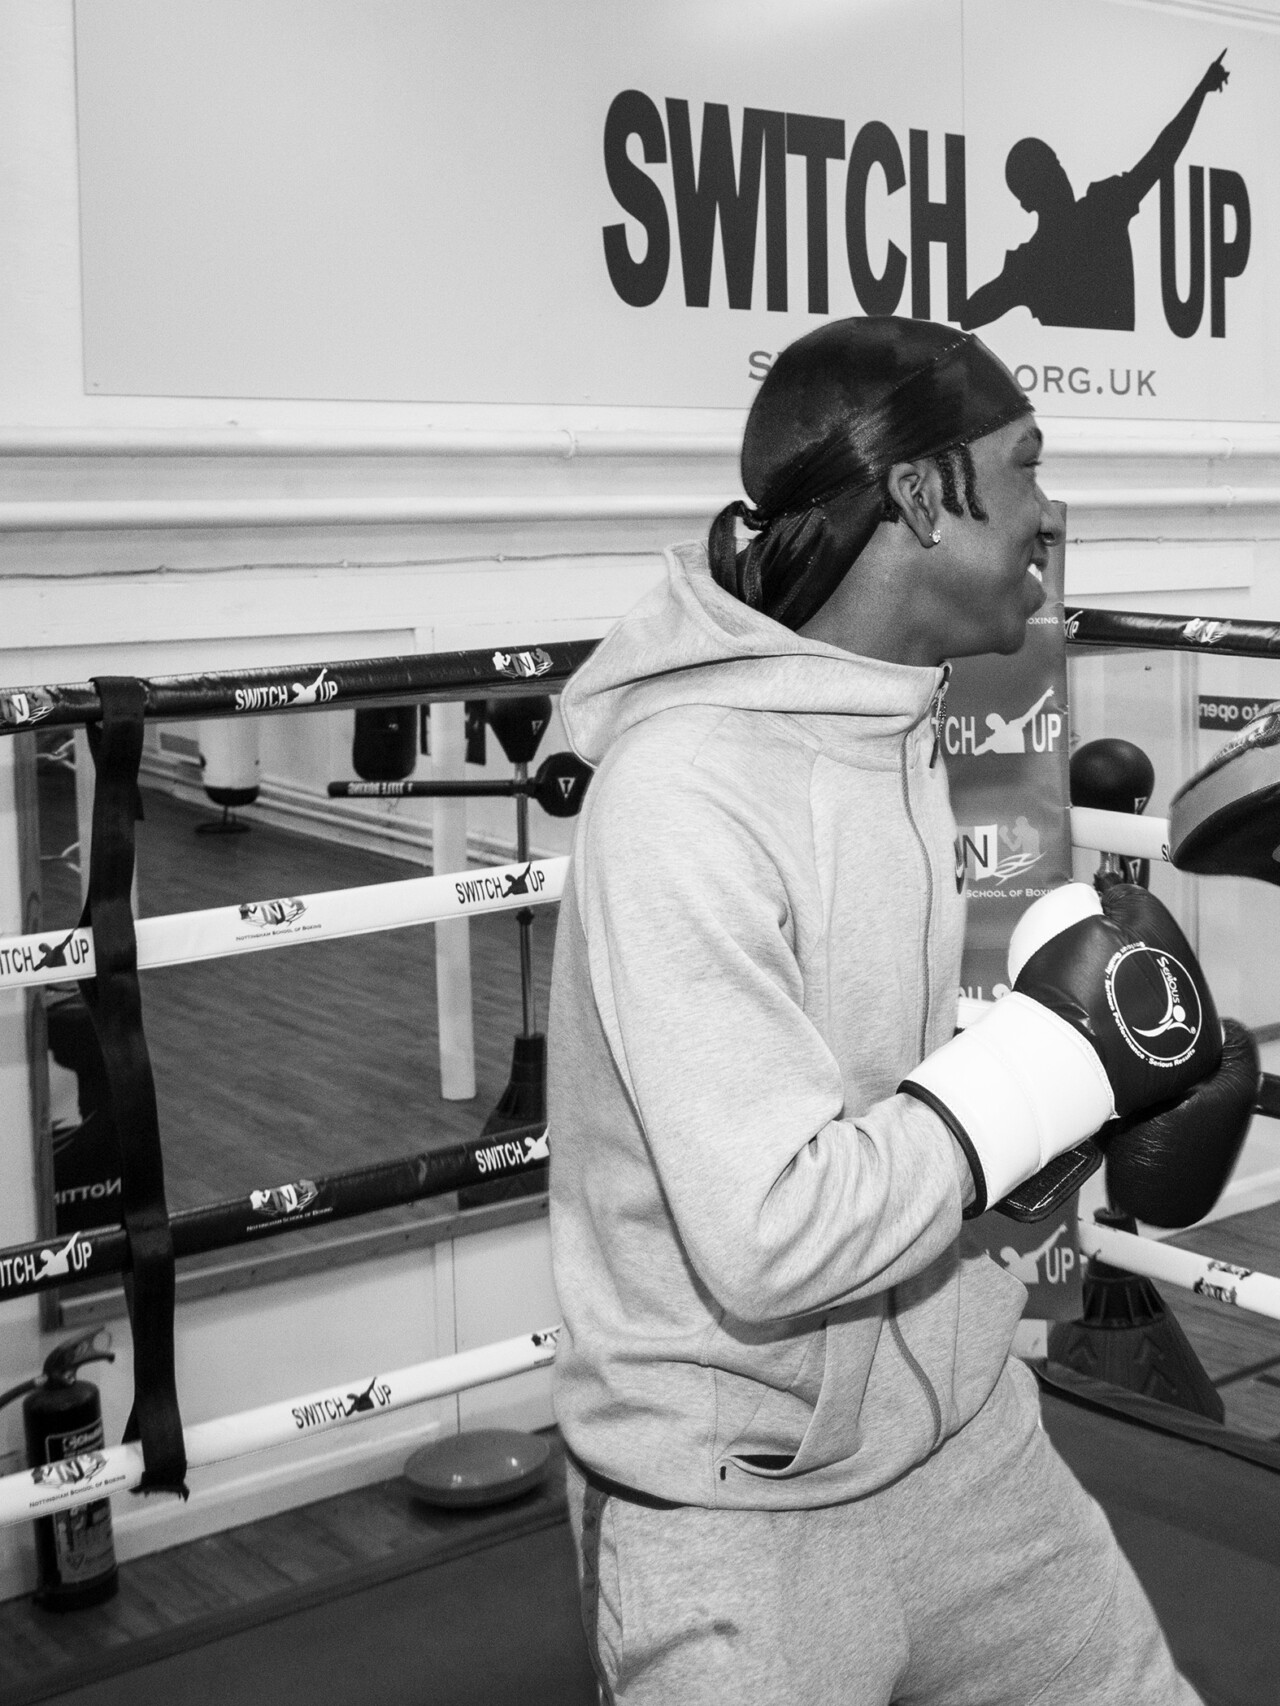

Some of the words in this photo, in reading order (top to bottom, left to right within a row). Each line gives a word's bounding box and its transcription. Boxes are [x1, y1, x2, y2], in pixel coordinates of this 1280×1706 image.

[602, 88, 968, 323] SWITCH
[1158, 164, 1251, 338] UP
[1016, 364, 1157, 397] ORG.UK
[1027, 616, 1059, 625] OXING
[235, 686, 289, 710] SWITCH
[319, 680, 338, 702] UP
[1031, 713, 1062, 753] UP
[455, 877, 504, 904] SWITCH
[528, 870, 545, 892] UP
[0, 946, 35, 975] ITCH
[69, 939, 89, 964] UP
[474, 1142, 524, 1173] SWITCH
[0, 1254, 36, 1288] ITCH
[71, 1241, 93, 1271] UP
[1045, 1247, 1075, 1284] UP
[291, 1397, 347, 1429] SWITCH
[373, 1384, 392, 1406] UP
